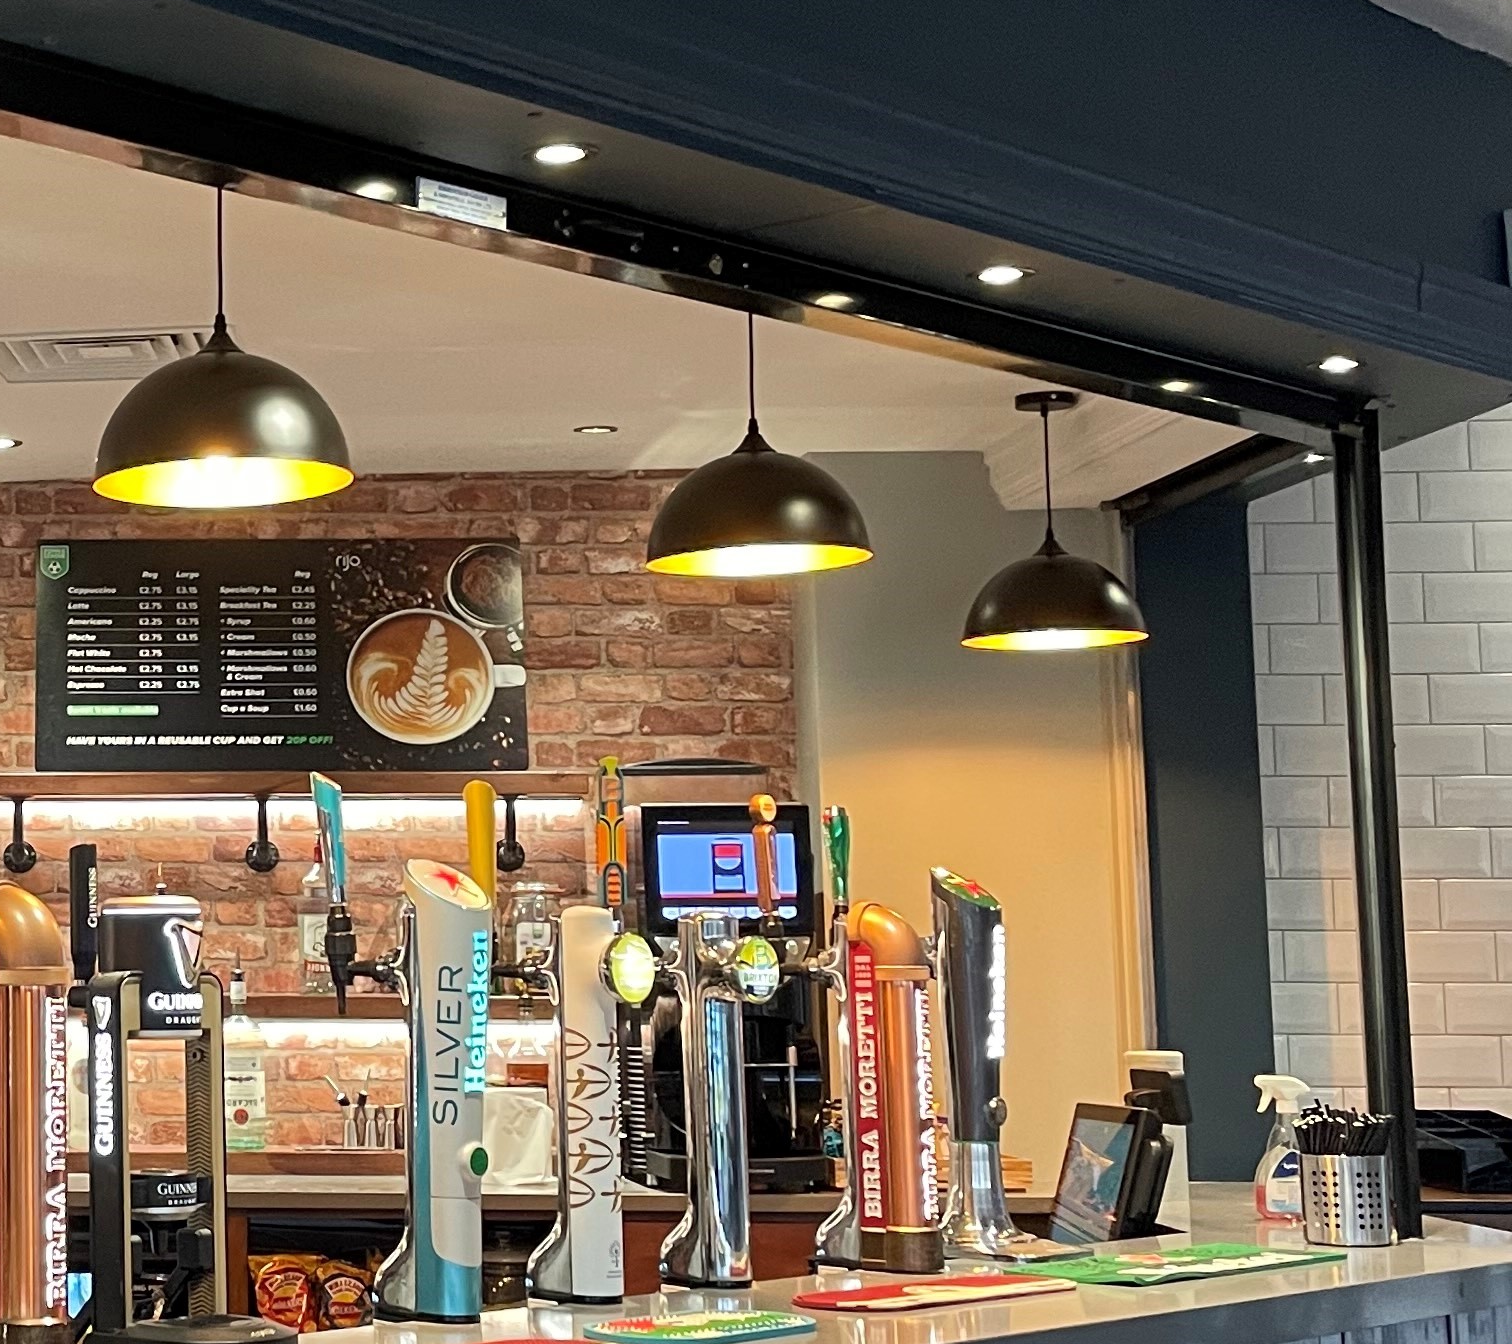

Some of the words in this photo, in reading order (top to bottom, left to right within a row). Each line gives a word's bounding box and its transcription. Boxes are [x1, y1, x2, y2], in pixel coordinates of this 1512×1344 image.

[335, 555, 361, 572] rijo
[67, 586, 117, 595] Cappuccino
[67, 601, 90, 610] Latte
[66, 617, 113, 626] Americano
[66, 633, 97, 642] Mocha
[84, 664, 127, 673] Chocolate
[220, 704, 239, 713] Cup
[66, 736, 96, 745] HAVE
[97, 736, 133, 745] YOURS
[134, 736, 147, 745] IN
[147, 736, 156, 745] A
[157, 736, 212, 745] REUSABLE
[212, 736, 236, 745] CUP
[236, 736, 261, 745] AND
[262, 736, 285, 745] GET
[286, 736, 307, 745] 20P
[308, 736, 334, 745] OFF!
[986, 923, 1006, 1060] Heineken
[464, 929, 489, 1094] Heineken
[432, 965, 463, 1126] SILVER
[855, 991, 879, 1119] MORETTI
[44, 996, 66, 1173] MORETTI
[94, 1032, 115, 1156] GUINNESS
[226, 1099, 258, 1107] BACARD
[861, 1129, 883, 1219] BIRRA
[45, 1182, 68, 1309] BIRRA
